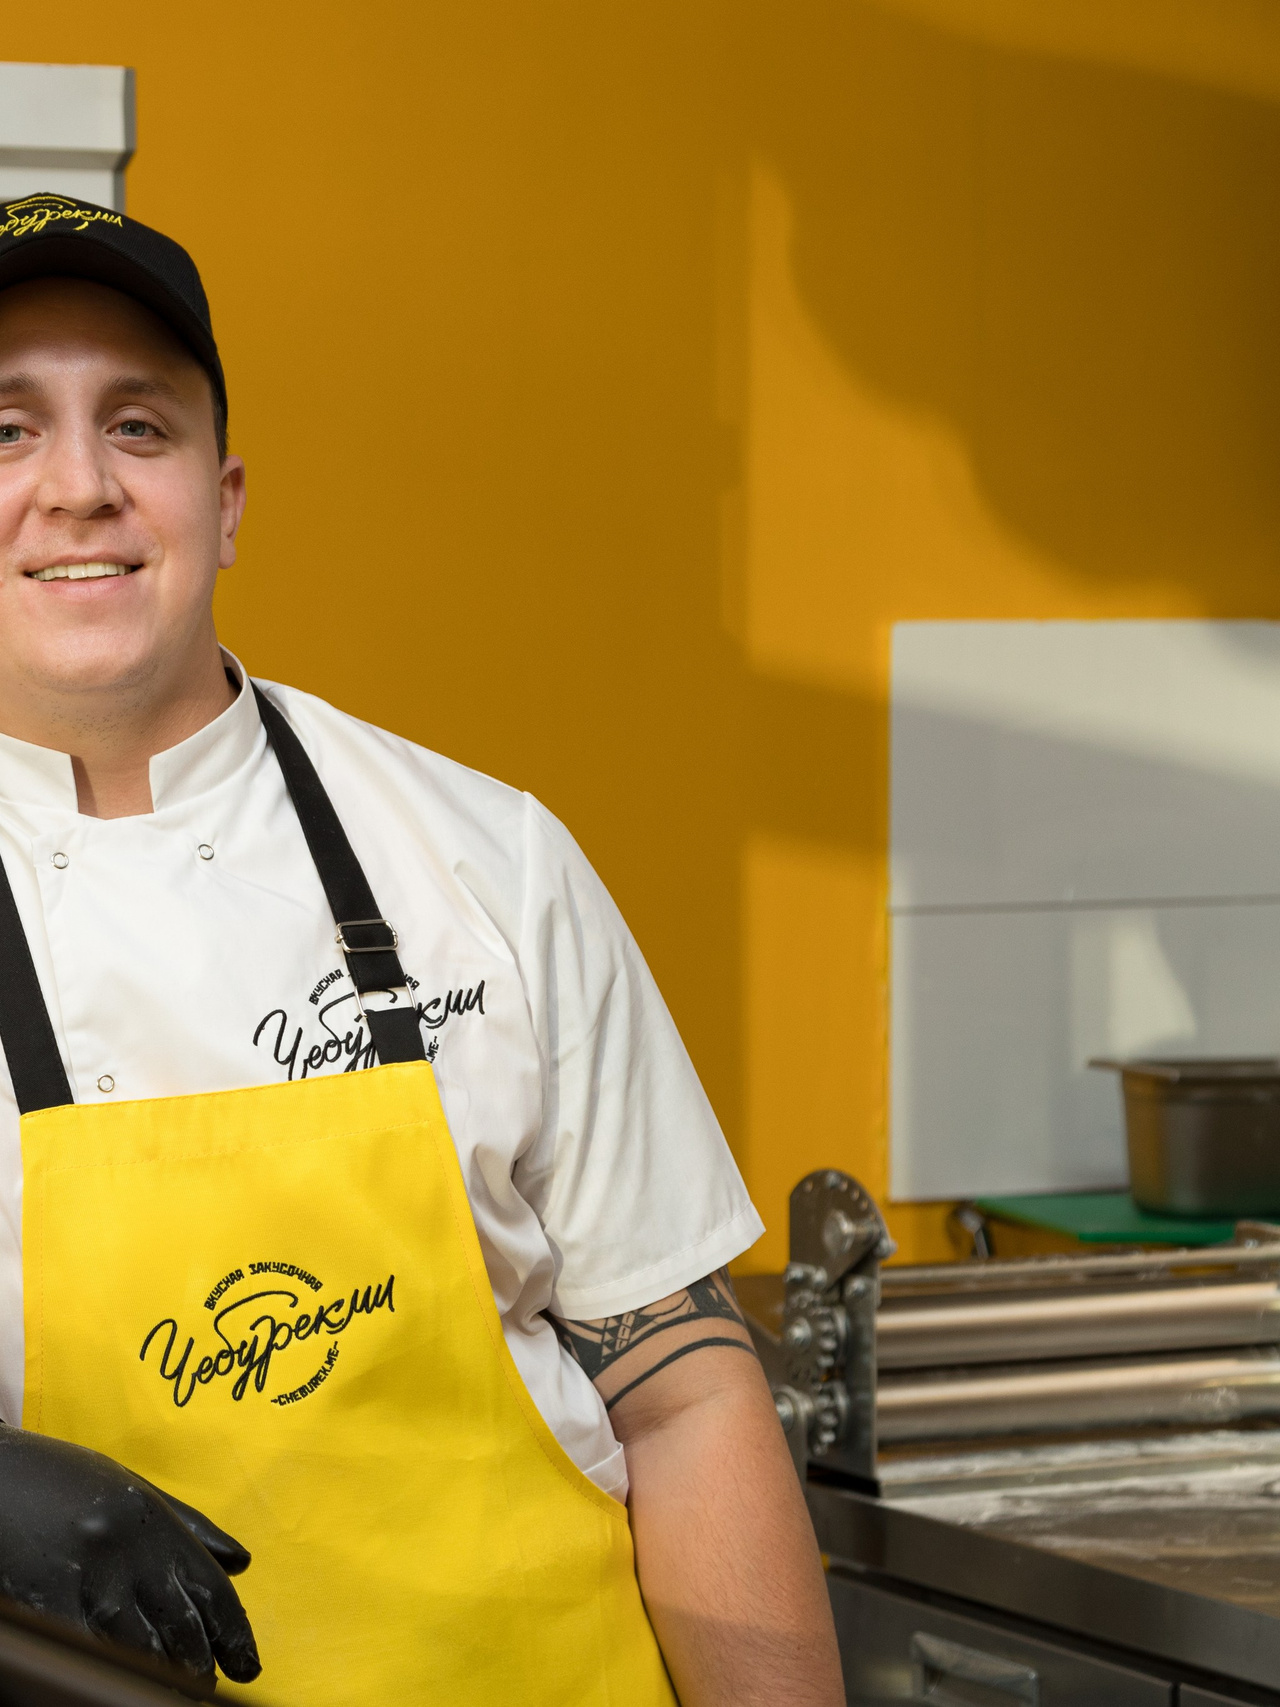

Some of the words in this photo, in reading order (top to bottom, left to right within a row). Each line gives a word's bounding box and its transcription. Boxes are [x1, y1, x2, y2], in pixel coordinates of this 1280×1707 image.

[308, 968, 344, 1006] ВКУСНАЯ
[204, 1269, 245, 1311] ВКУСНАЯ
[248, 1261, 324, 1293] ЗАКУСОЧНАЯ
